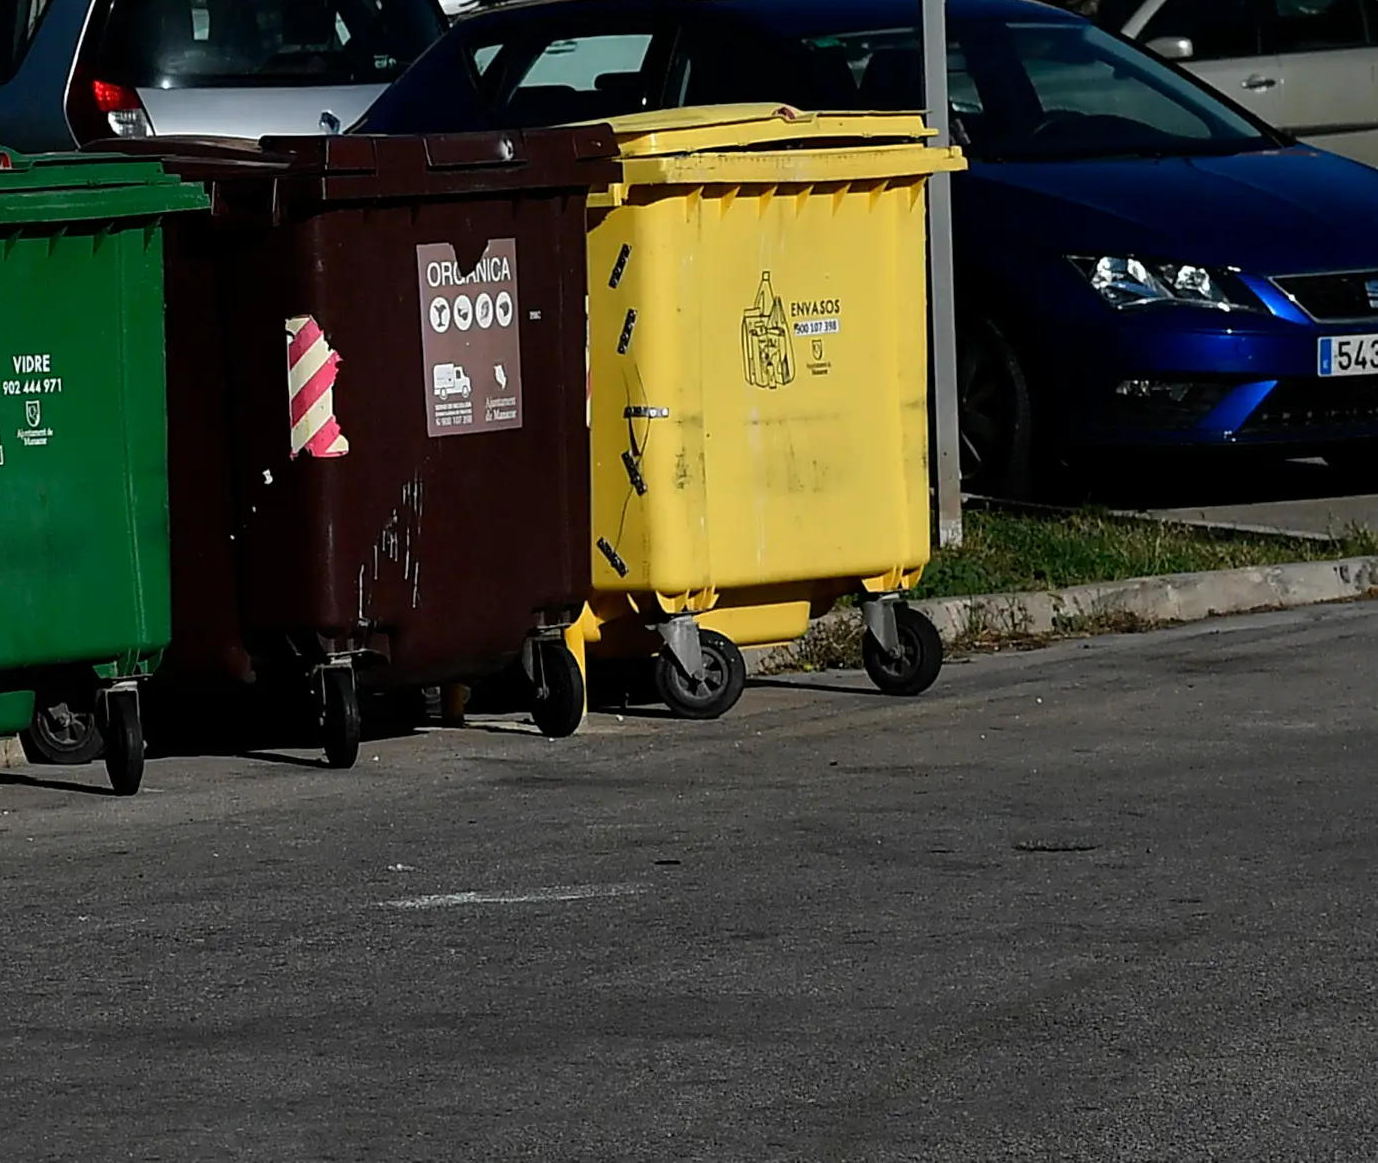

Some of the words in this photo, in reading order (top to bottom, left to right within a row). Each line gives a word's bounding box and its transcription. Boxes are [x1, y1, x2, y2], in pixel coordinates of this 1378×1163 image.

[791, 299, 840, 317] ENVASOS
[810, 321, 823, 333] 107
[12, 354, 51, 374] VIDRE
[2, 380, 21, 395] 902
[23, 379, 41, 394] 444
[43, 378, 62, 393] 971
